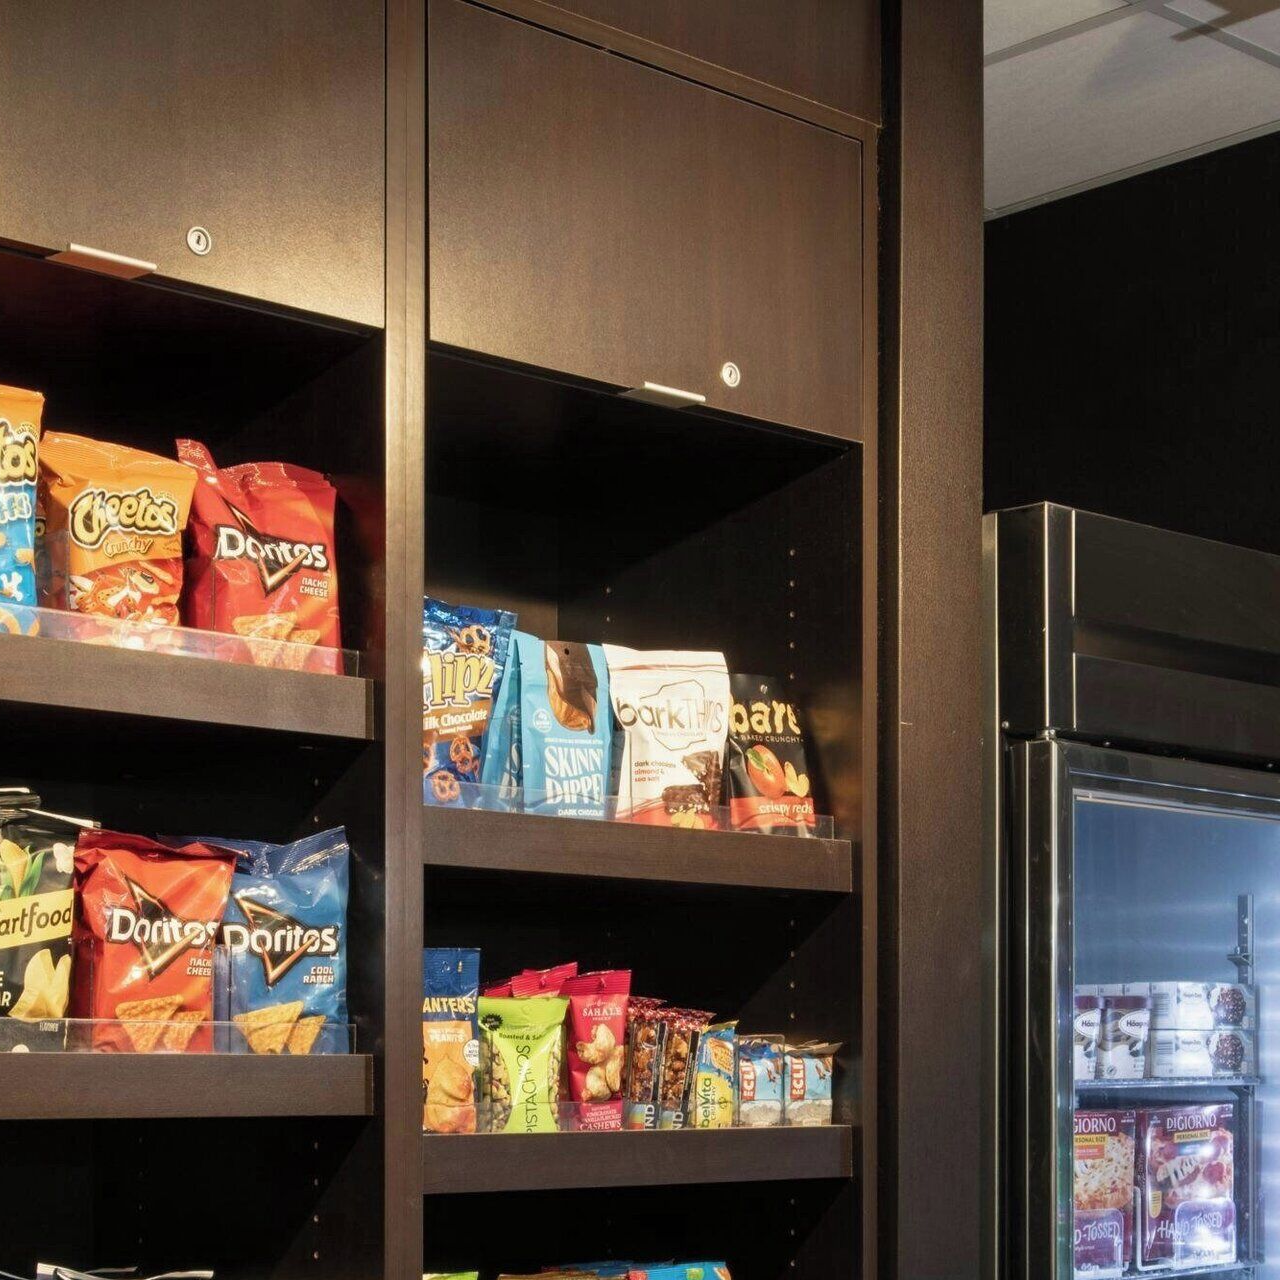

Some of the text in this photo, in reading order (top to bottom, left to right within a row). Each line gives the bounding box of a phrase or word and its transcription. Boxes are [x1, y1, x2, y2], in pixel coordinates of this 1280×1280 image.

[72, 490, 177, 546] Cheetos
[219, 526, 327, 568] Doritos
[301, 577, 327, 589] NACHO
[299, 586, 328, 597] CHEESE
[224, 924, 338, 953] Doritos
[311, 967, 334, 975] COOL
[303, 975, 334, 984] RANCH
[701, 1077, 712, 1128] belVita
[579, 1121, 622, 1131] CASHEWS
[1175, 1131, 1209, 1141] PERSONAL SIZE
